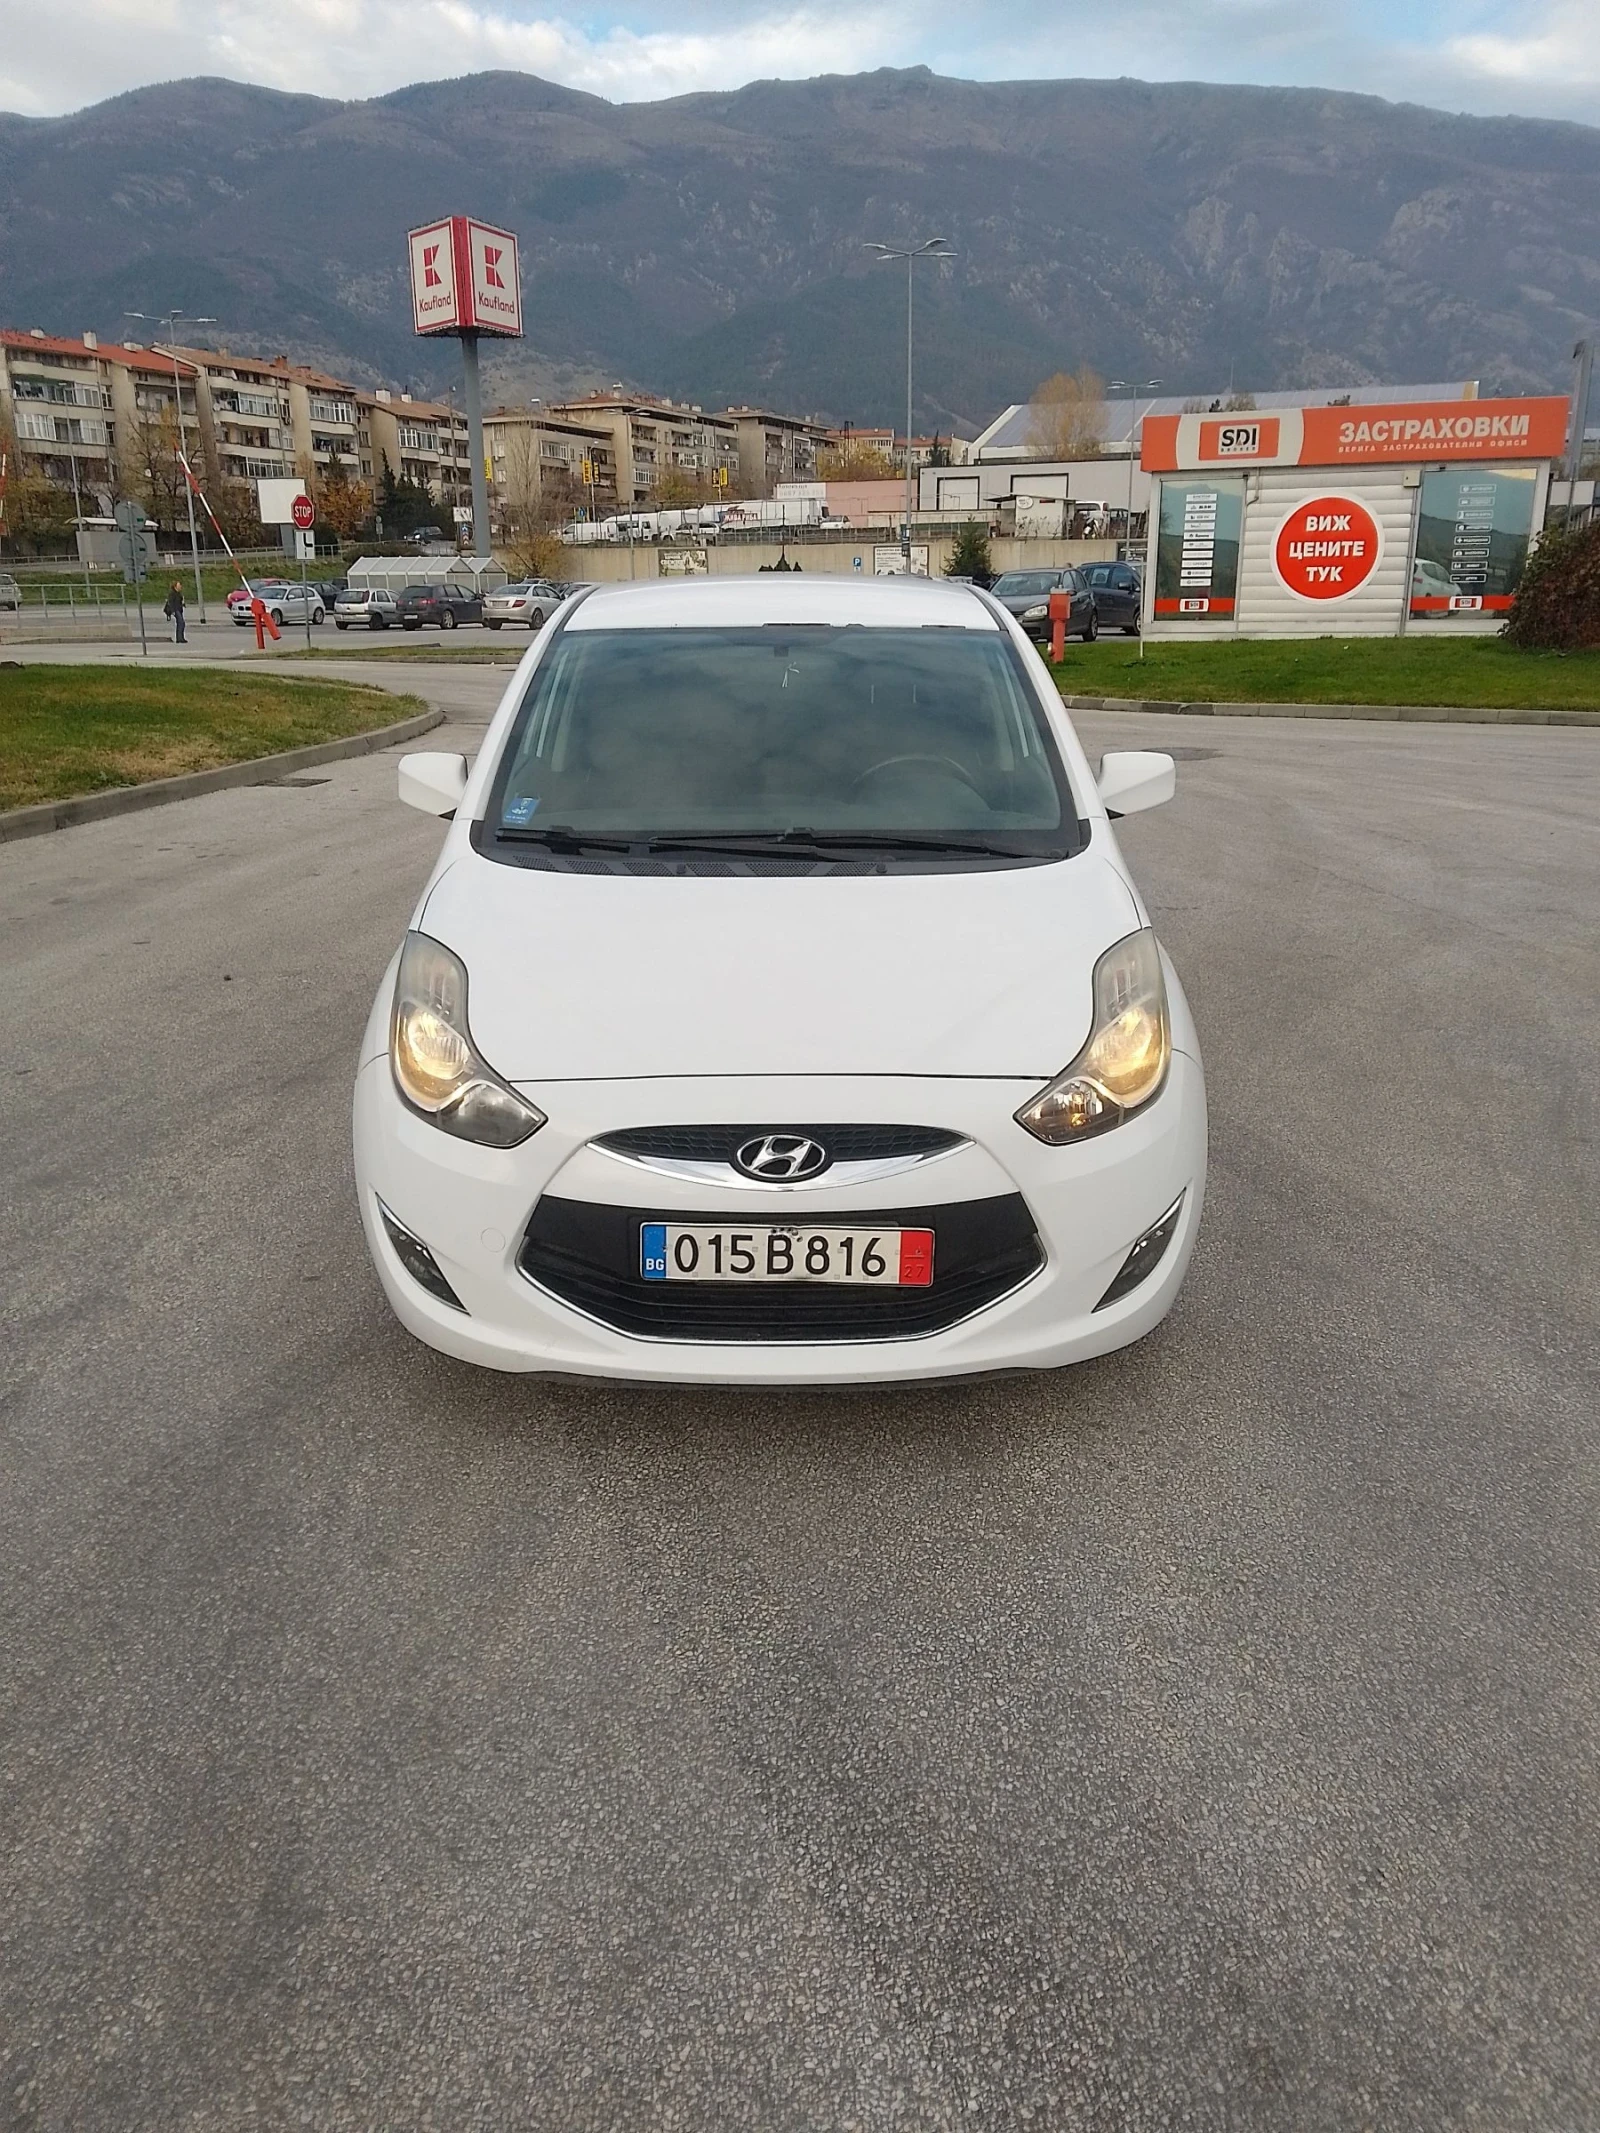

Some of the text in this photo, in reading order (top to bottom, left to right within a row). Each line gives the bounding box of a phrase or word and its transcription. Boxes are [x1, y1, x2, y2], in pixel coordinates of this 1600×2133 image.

[419, 292, 451, 313] Kaufland
[478, 291, 515, 314] Kaufland
[1221, 427, 1257, 447] SDI
[1338, 414, 1530, 443] ЗАСТРАХОВКИ
[1338, 439, 1528, 453] ВЕРИГА ЗАСТРАХОВАТЕЛНИ ОФИСИ
[294, 505, 311, 518] STOP
[1305, 514, 1351, 533] ВИЖ
[1288, 539, 1365, 560] ЦЕНИТЕ
[1305, 565, 1344, 583] ТУК
[645, 1258, 665, 1271] BG
[674, 1233, 887, 1278] 015B816
[903, 1264, 924, 1278] 27
